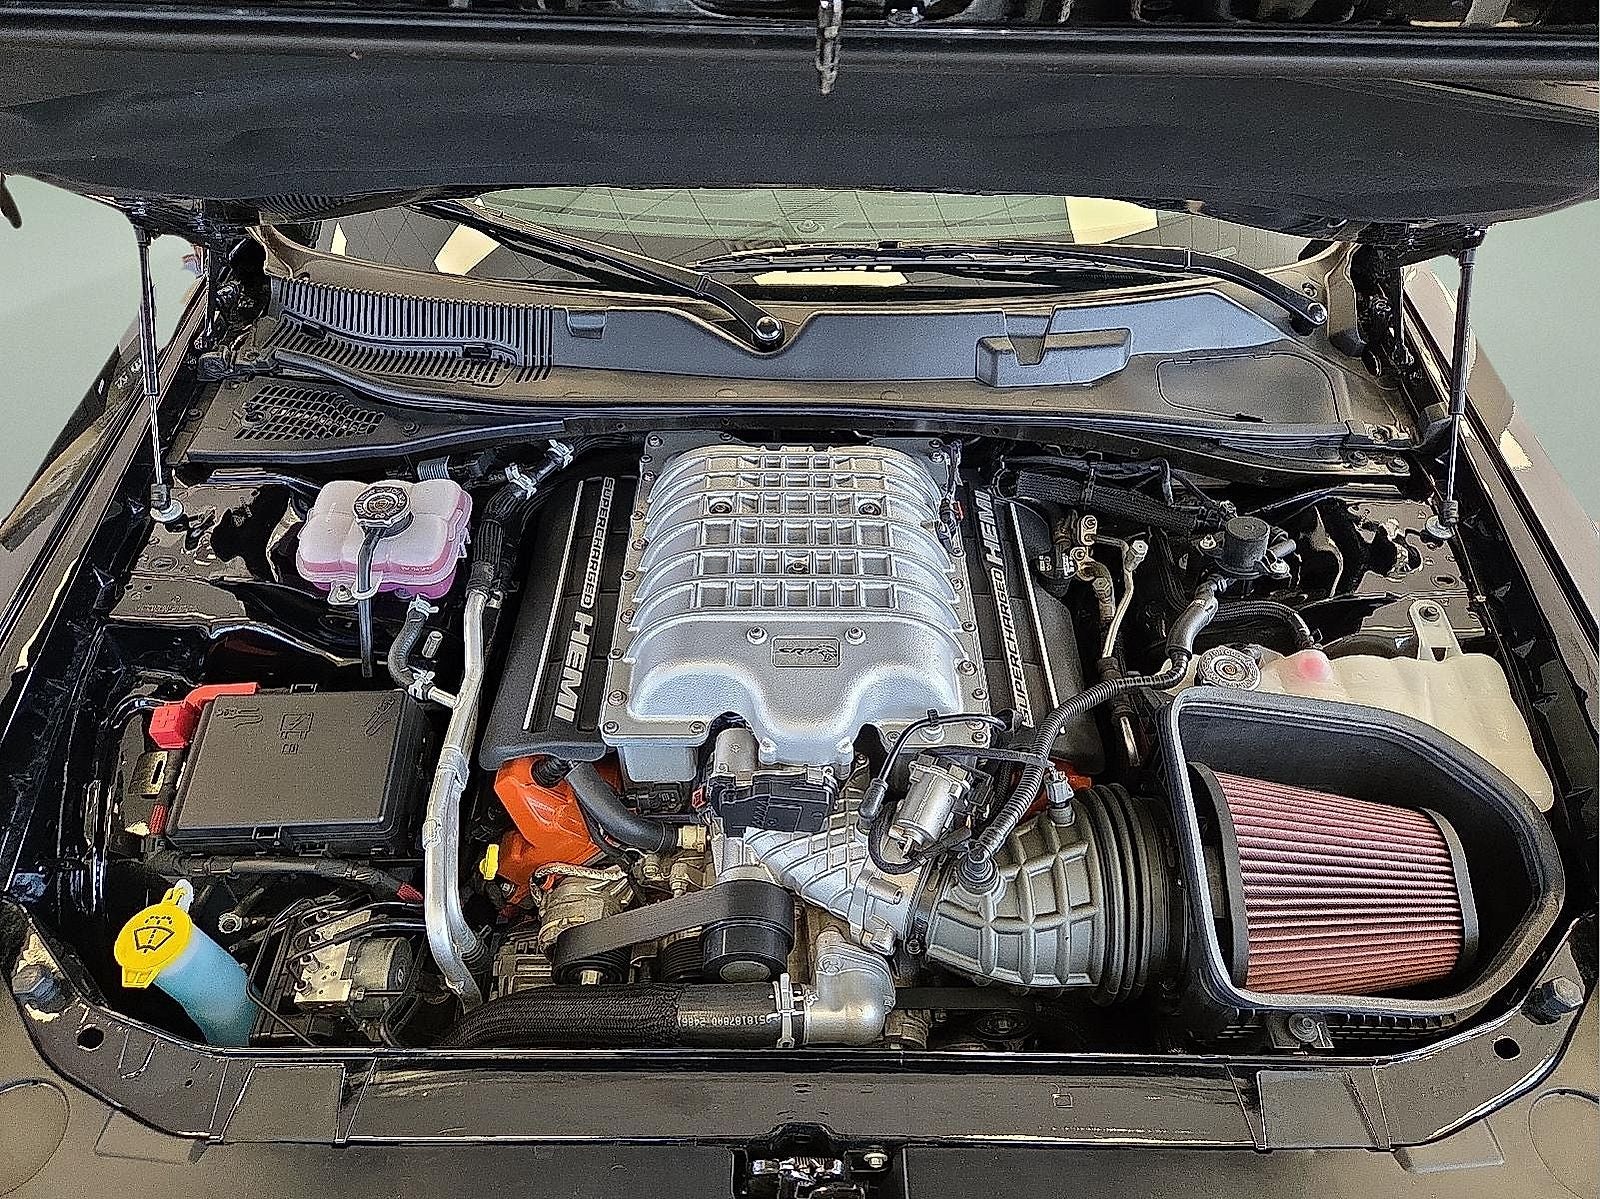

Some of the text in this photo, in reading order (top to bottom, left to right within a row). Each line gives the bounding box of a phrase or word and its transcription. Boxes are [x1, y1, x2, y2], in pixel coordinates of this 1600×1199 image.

[554, 476, 615, 723] SUPERCHARGED HEMI
[974, 489, 1035, 728] SUPERCHARGED HEMI
